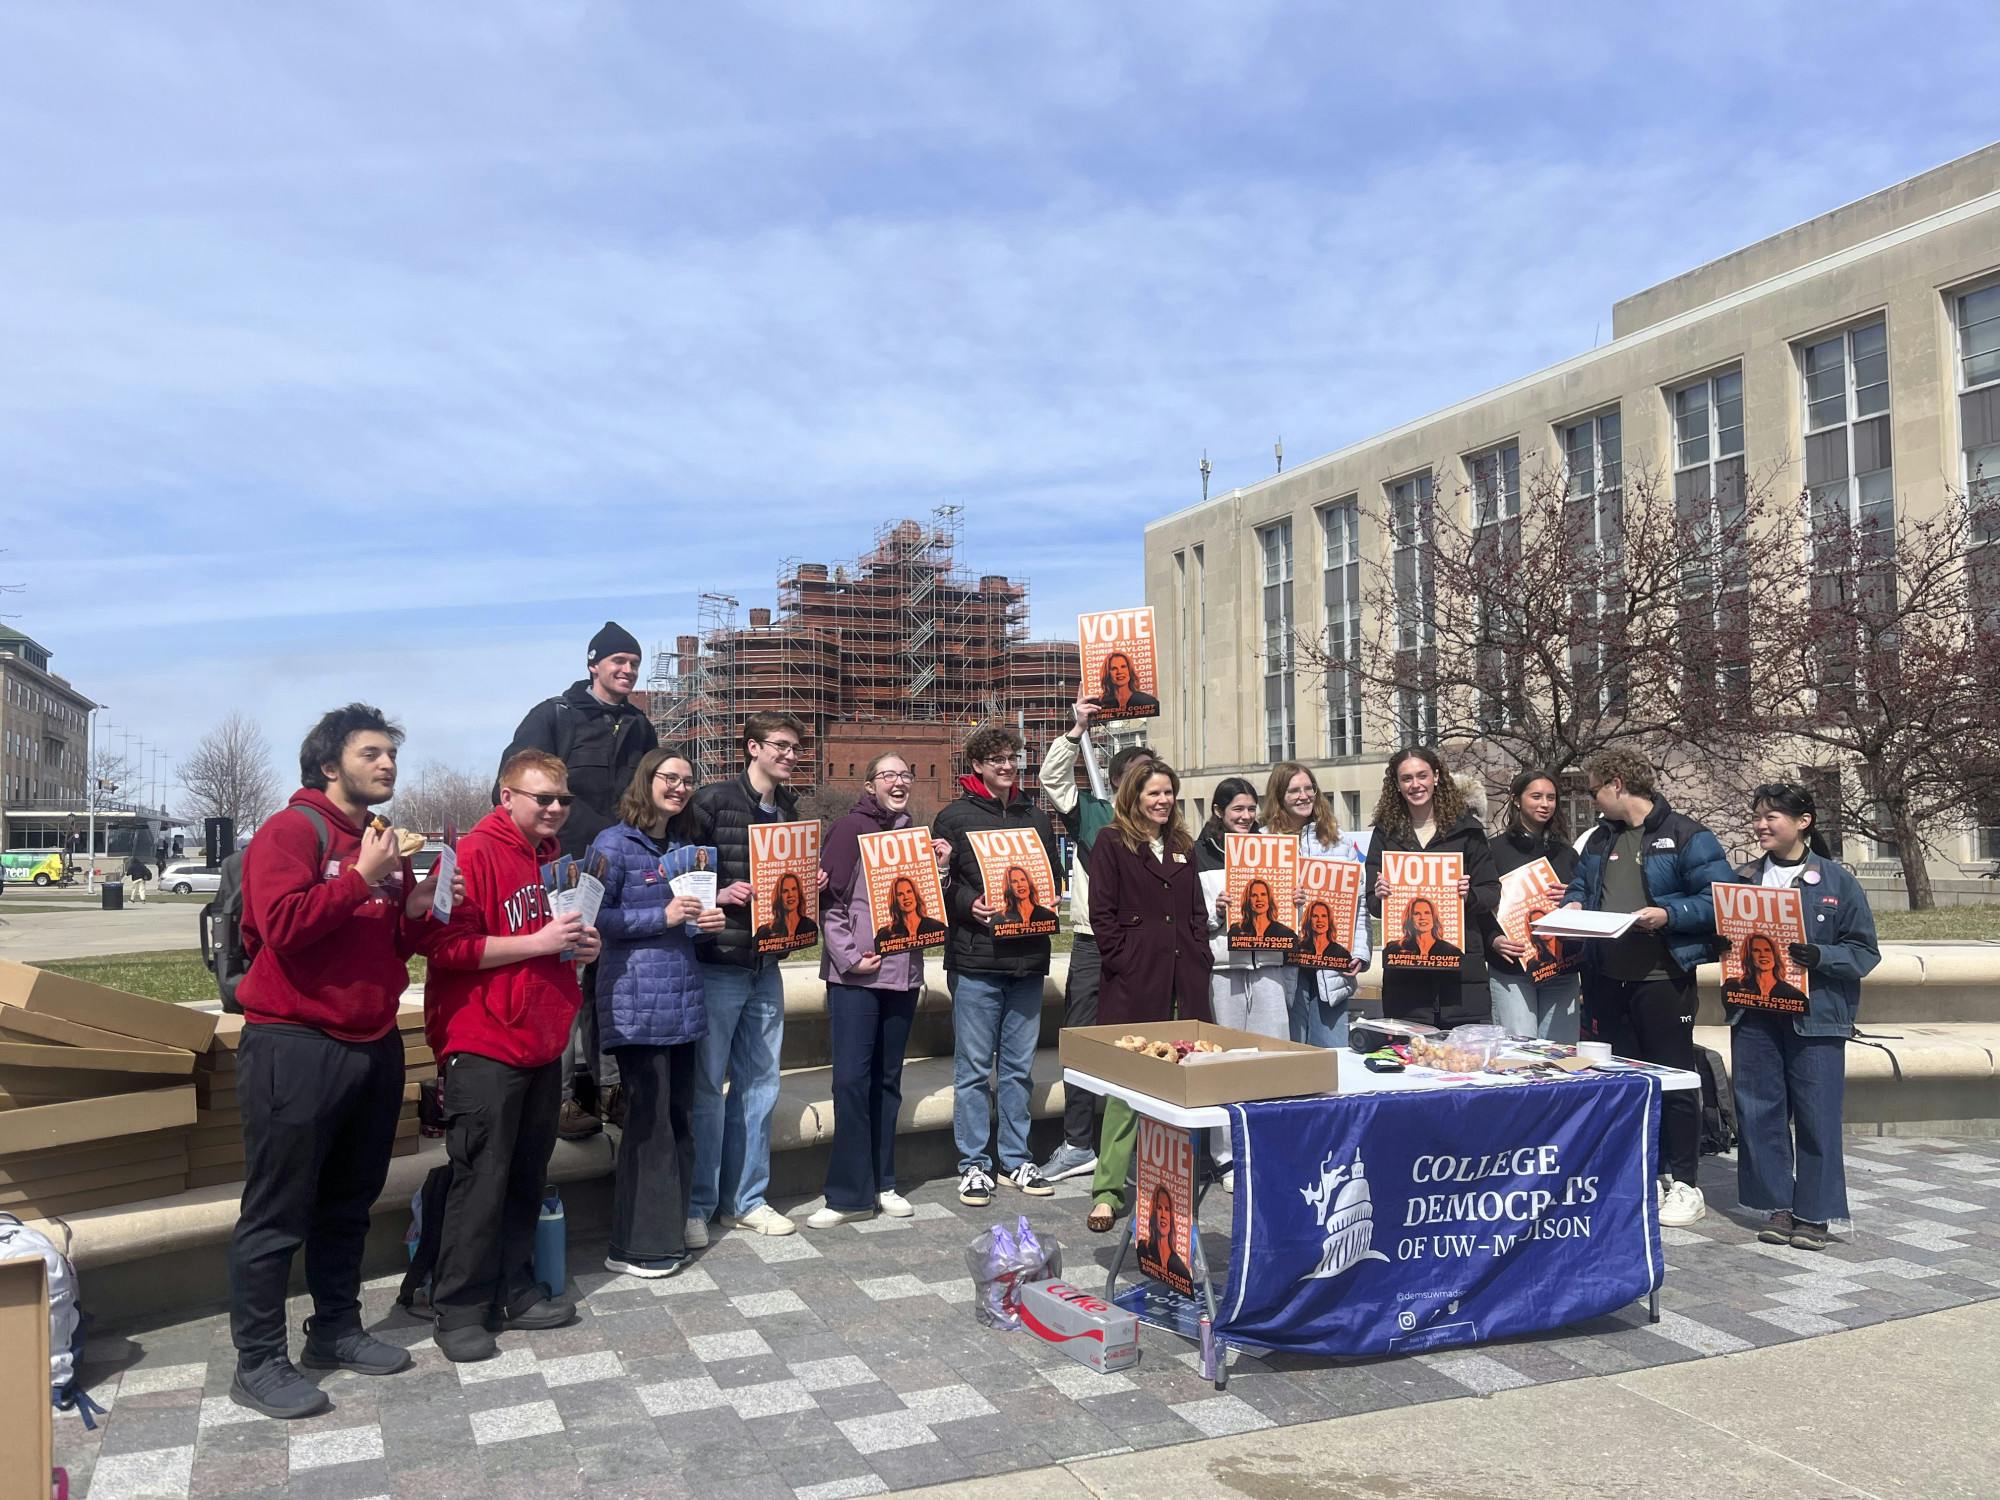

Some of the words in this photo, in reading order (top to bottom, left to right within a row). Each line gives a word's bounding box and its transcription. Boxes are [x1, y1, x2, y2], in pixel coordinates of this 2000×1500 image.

[1082, 610, 1150, 643] VOTE
[1115, 638, 1150, 647] TAYLOR
[752, 825, 817, 861] VOTE
[862, 831, 931, 868] VOTE
[971, 831, 1040, 857] VOTE
[1228, 837, 1294, 867] VOTE
[787, 858, 816, 866] TAYLOR
[870, 865, 898, 875] CHRIS
[899, 860, 932, 870] TAYLOR
[5, 867, 30, 878] reen
[1300, 860, 1357, 893] VOTE
[1386, 855, 1458, 886] VOTE
[1320, 890, 1353, 898] TAYLOR
[1716, 887, 1797, 924] VOTE
[994, 922, 1030, 930] SUPREME
[994, 928, 1020, 936] APRIL
[1756, 922, 1798, 931] TAYLOR
[880, 935, 917, 946] SUPREME
[919, 930, 945, 941] COURT
[758, 943, 784, 952] APRIL
[786, 941, 800, 949] 7TH
[880, 942, 907, 953] APRIL
[908, 940, 924, 948] 7TH
[1727, 991, 1769, 1002] SUPREME
[1771, 996, 1804, 1006] COURT
[1727, 997, 1756, 1006] APRIL
[1139, 1119, 1191, 1177] VOTE
[1412, 1145, 1561, 1183] COLLEGE
[1141, 1162, 1160, 1176] CHRIS
[1162, 1169, 1188, 1186] TAYLOR
[1398, 1237, 1427, 1260] OF
[1142, 1265, 1160, 1280] APRIL
